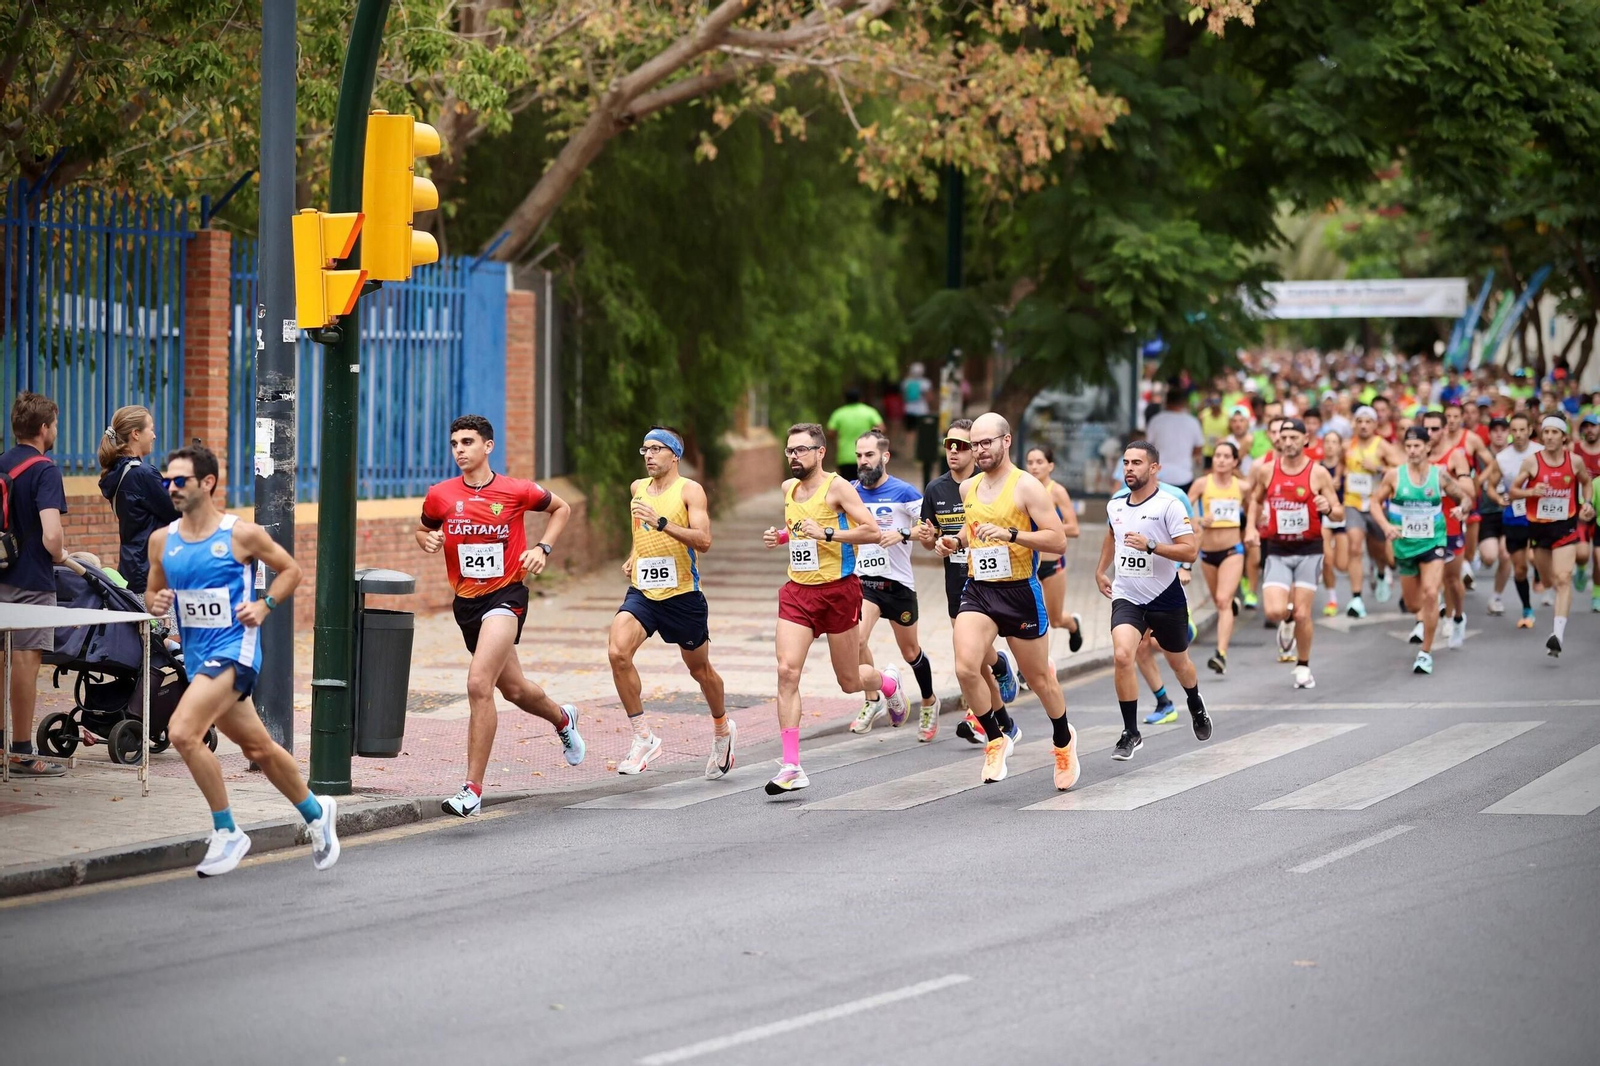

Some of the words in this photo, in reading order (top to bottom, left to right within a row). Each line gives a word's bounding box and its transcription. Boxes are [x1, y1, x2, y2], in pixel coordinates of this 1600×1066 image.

[1214, 507, 1235, 516] 477
[1281, 518, 1304, 527] 732
[1407, 523, 1428, 531] 403
[465, 556, 495, 568] 241
[857, 557, 886, 568] 1200
[979, 558, 998, 570] 33
[1120, 557, 1146, 568] 790
[641, 567, 669, 580] 796
[185, 603, 221, 616] 510
